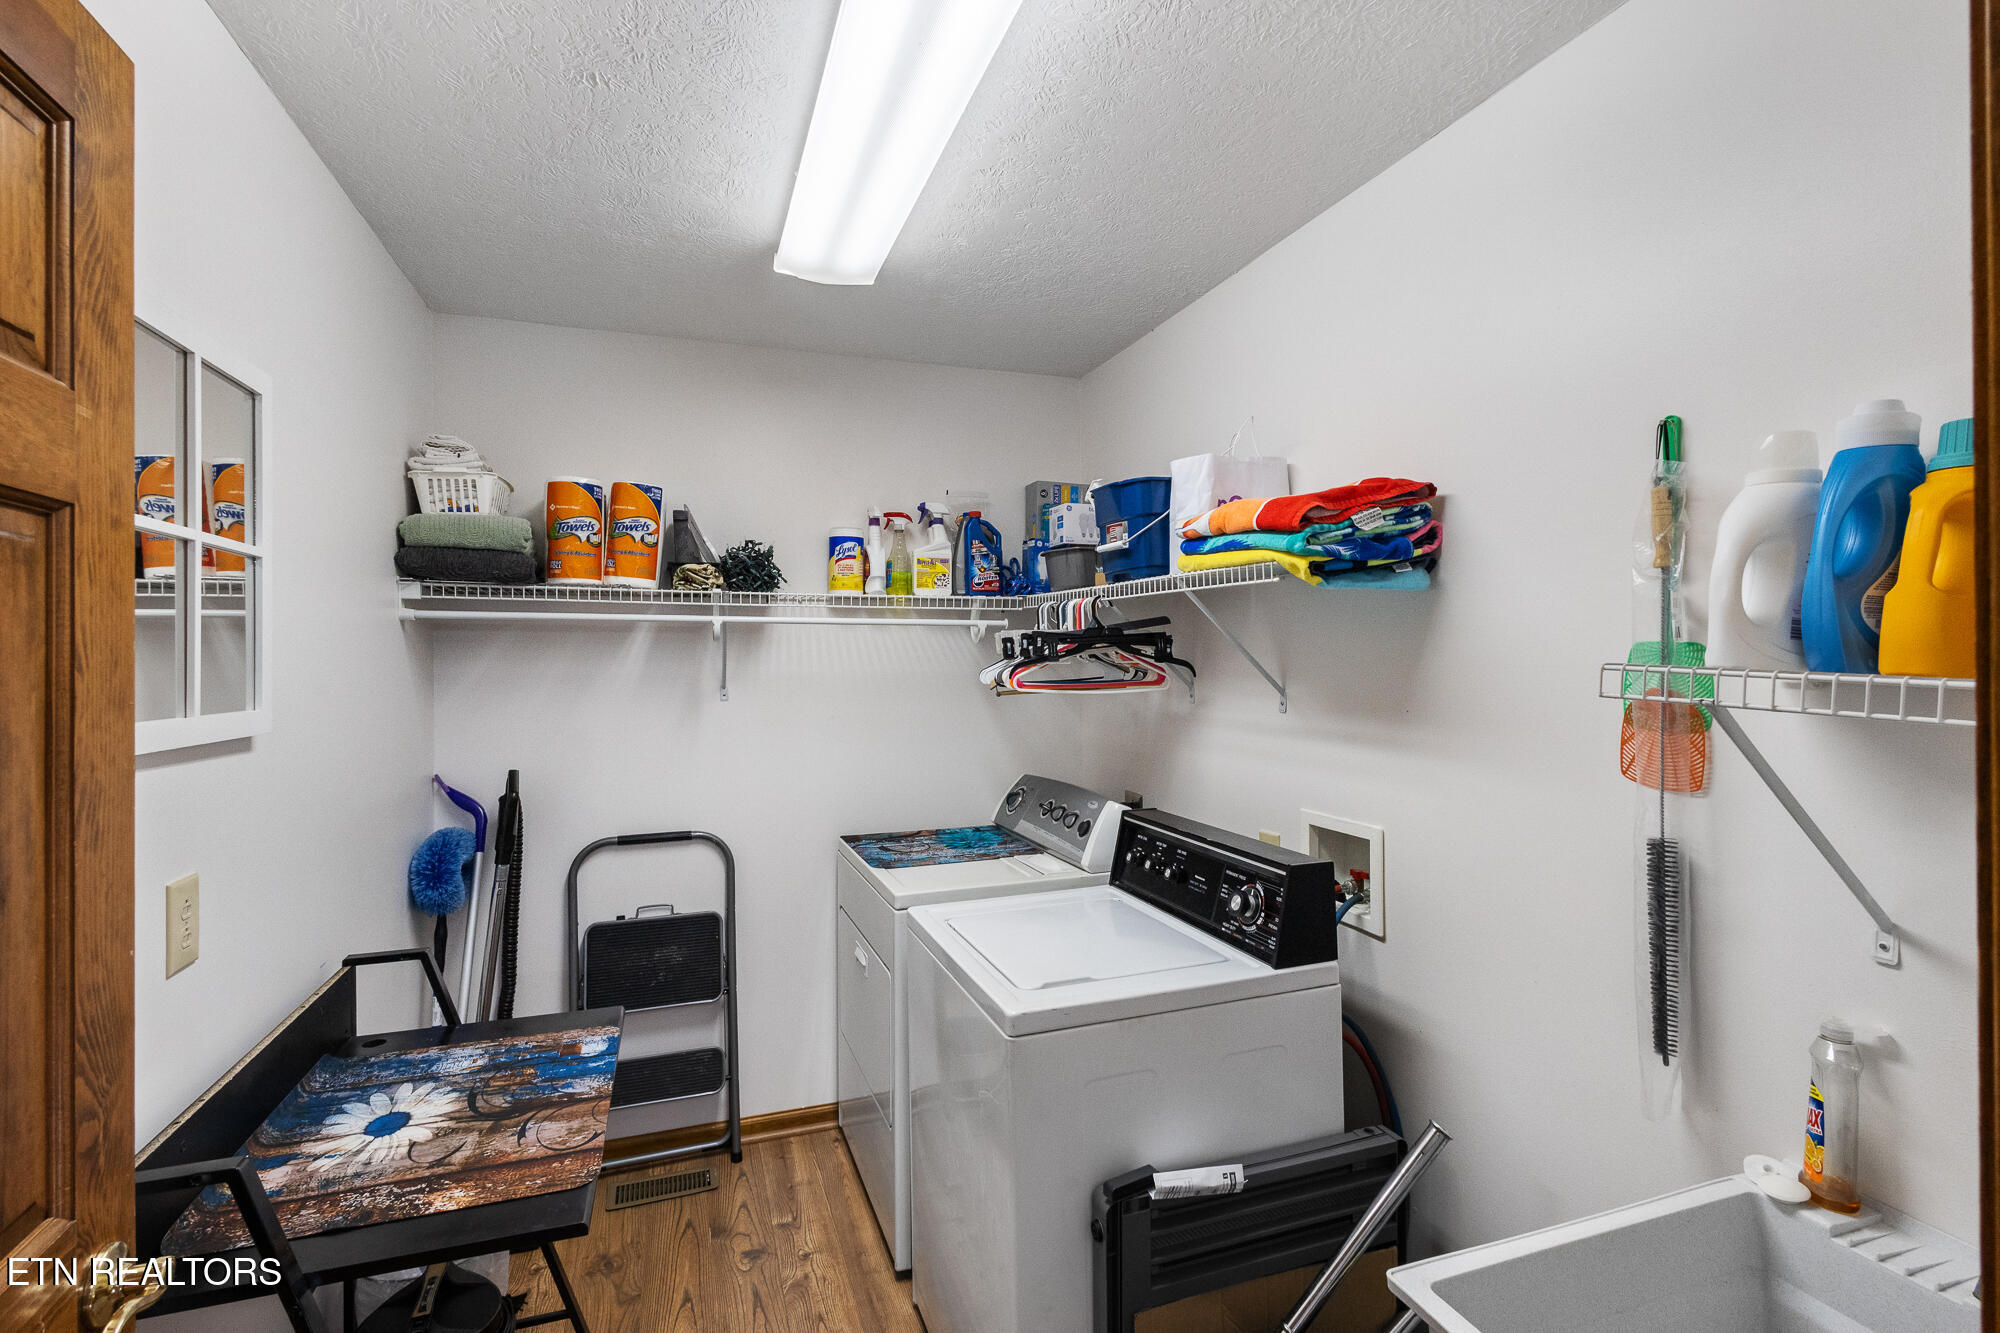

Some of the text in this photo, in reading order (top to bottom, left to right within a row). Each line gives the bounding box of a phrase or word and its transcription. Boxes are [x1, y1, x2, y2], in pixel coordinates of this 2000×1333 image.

[556, 521, 595, 534] Towels
[613, 521, 651, 534] Towels
[836, 543, 858, 558] Lysol
[1807, 1107, 1821, 1129] AX
